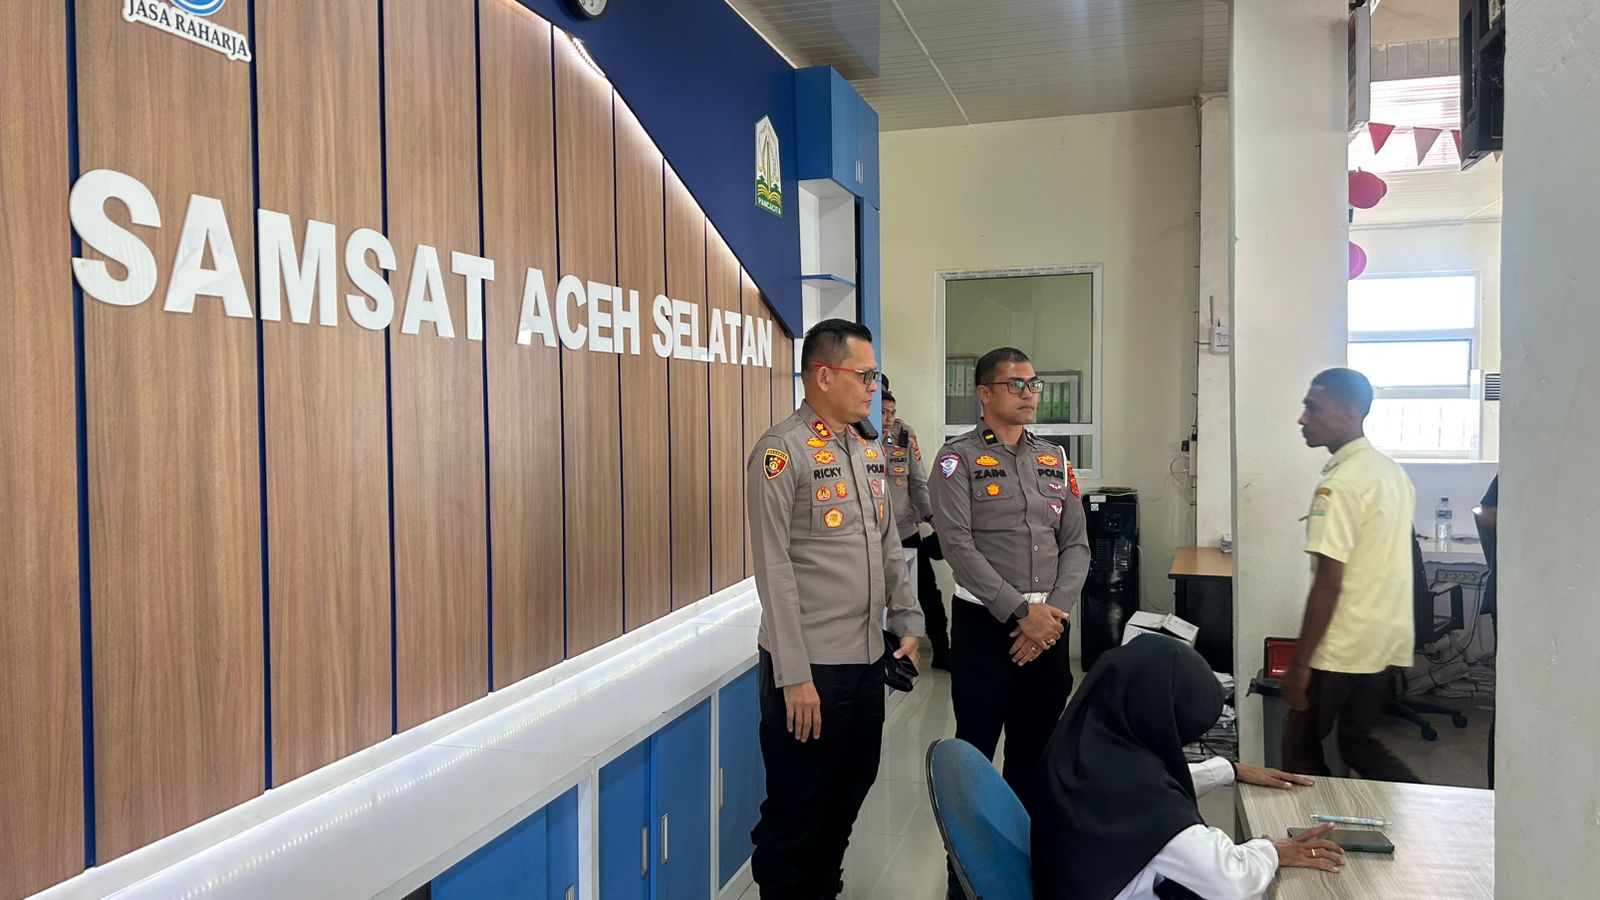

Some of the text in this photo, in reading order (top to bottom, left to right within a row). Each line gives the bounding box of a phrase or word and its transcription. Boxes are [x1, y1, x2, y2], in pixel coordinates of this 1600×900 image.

[128, 0, 248, 57] JASA RAHARJA
[757, 197, 782, 215] PANCACITA
[69, 168, 773, 368] SAMSAT ACEH SELATAN
[813, 467, 842, 480] RICKY
[974, 469, 1007, 480] ZAINI
